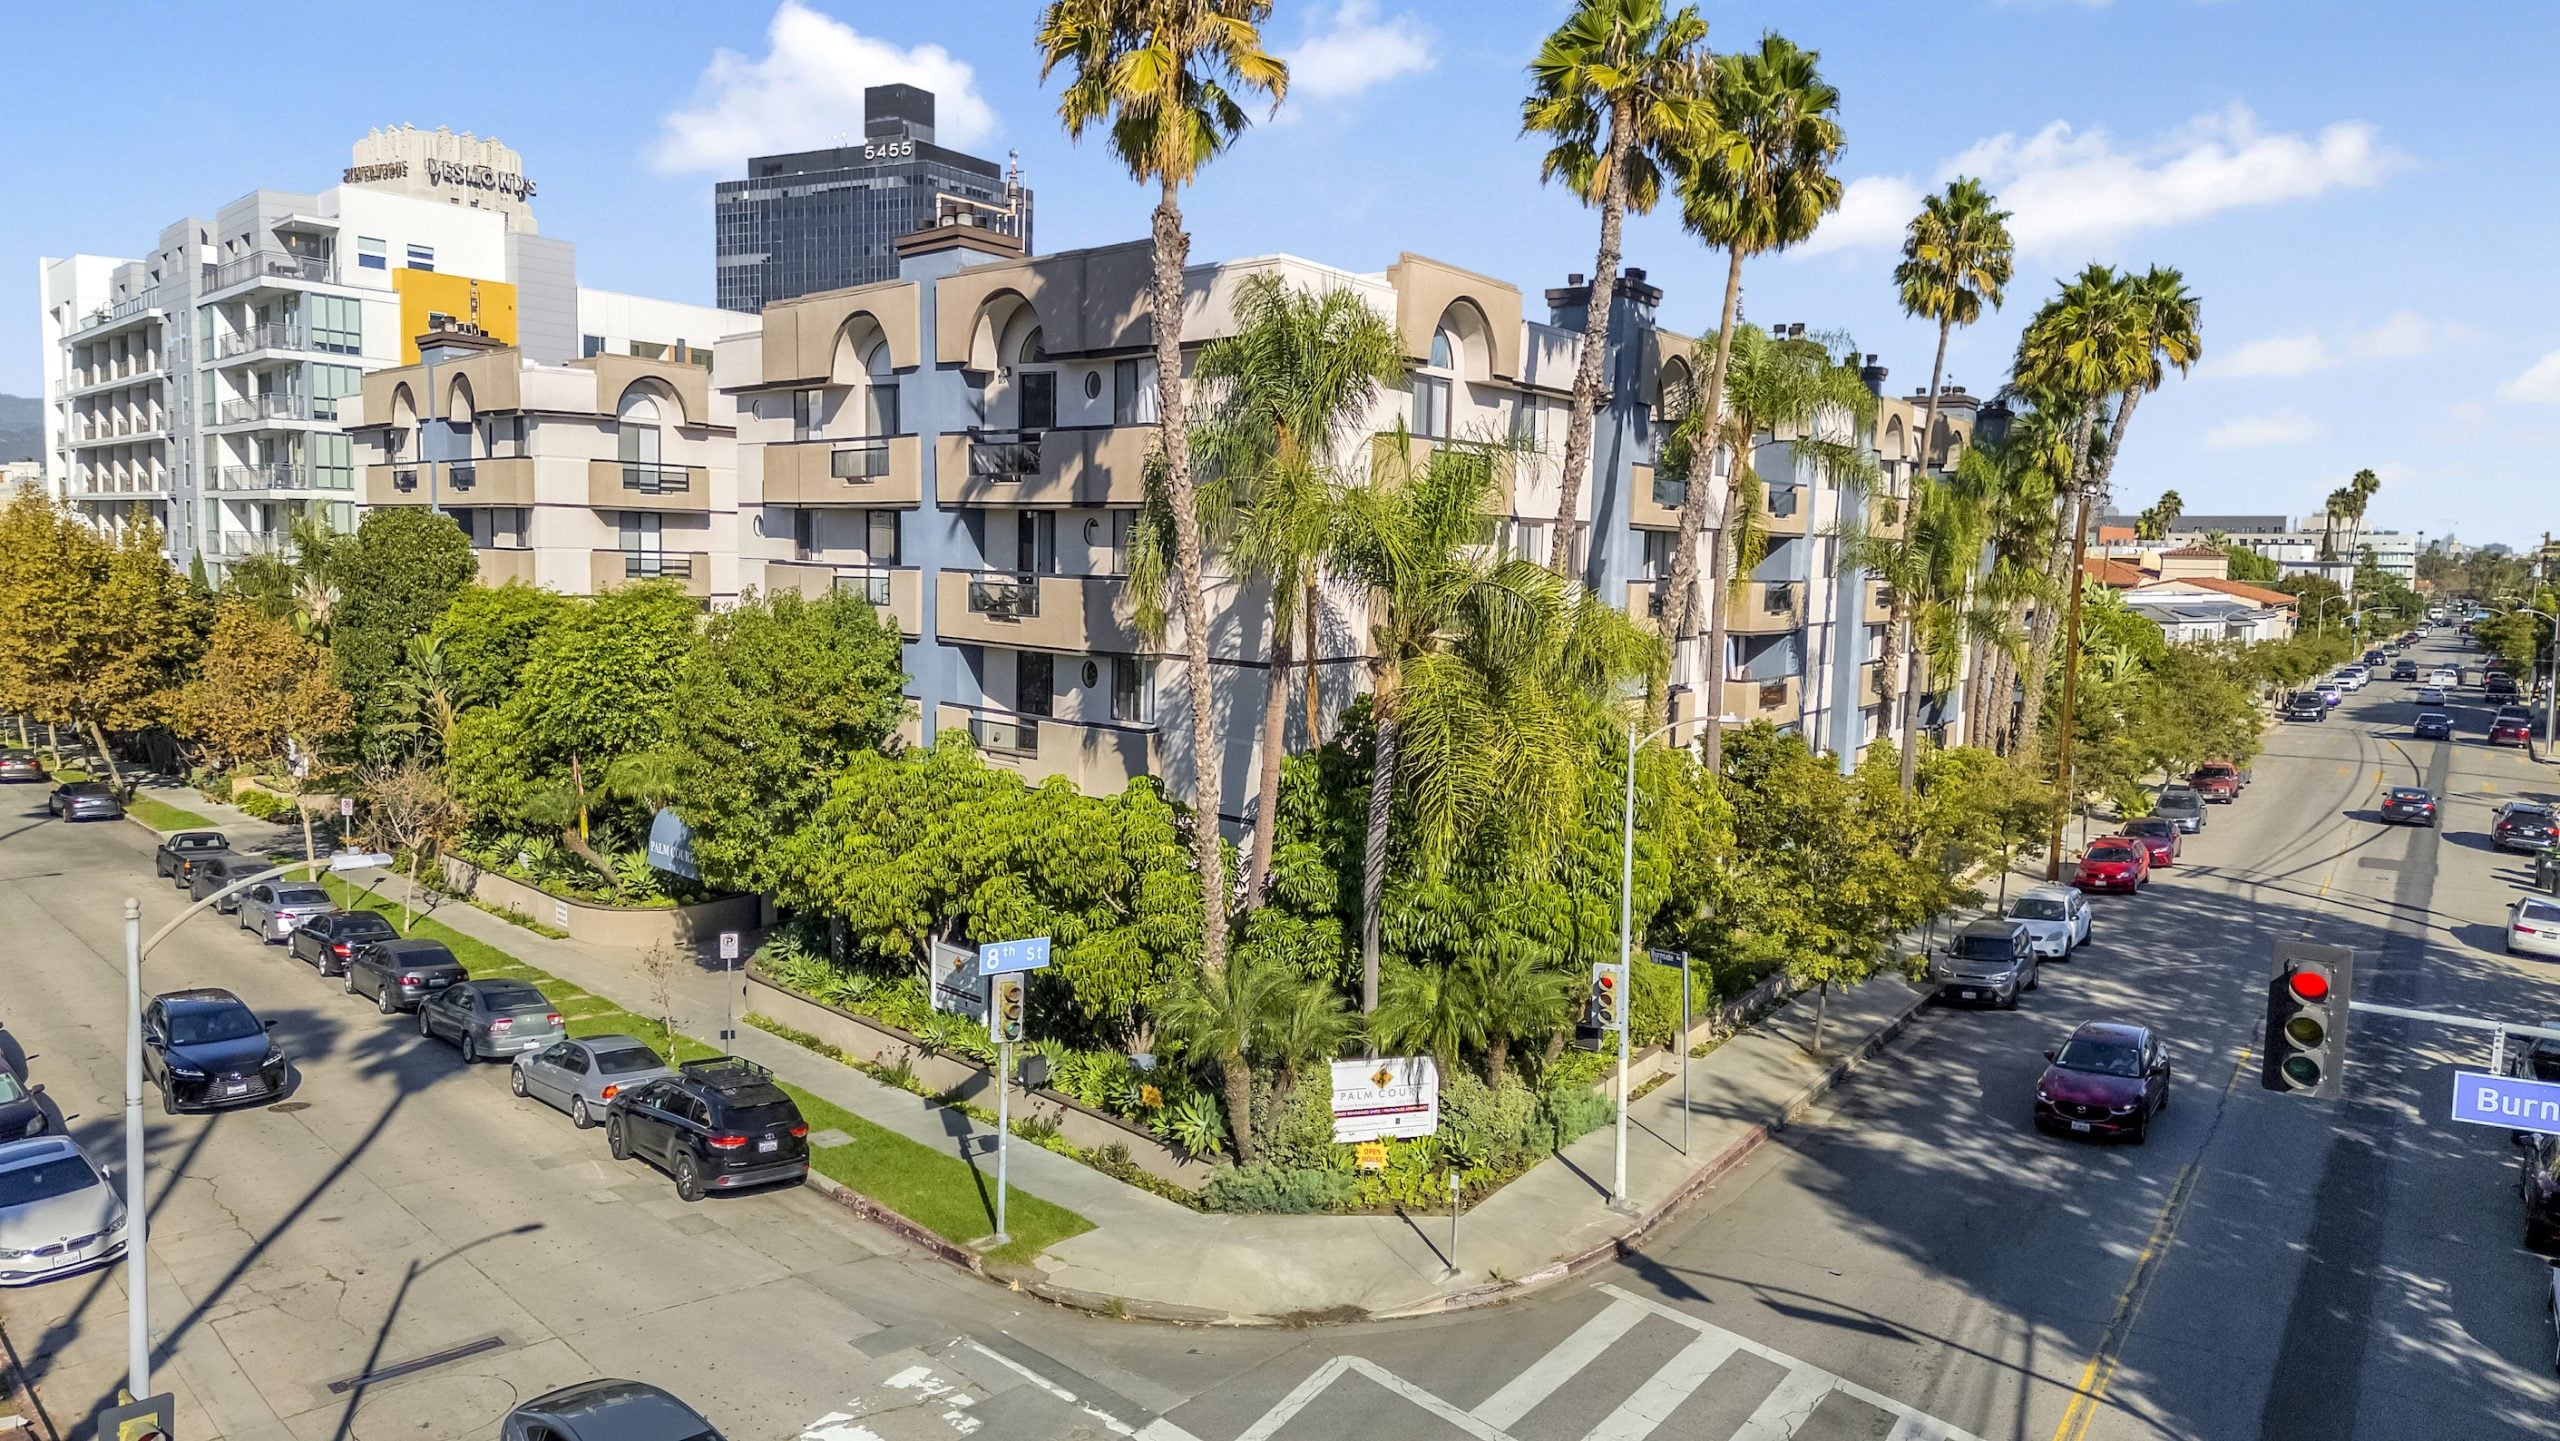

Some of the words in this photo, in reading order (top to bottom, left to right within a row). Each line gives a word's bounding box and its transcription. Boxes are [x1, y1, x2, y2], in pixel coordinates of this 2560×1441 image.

[864, 141, 912, 160] 5455
[651, 841, 670, 857] PALM
[986, 945, 1016, 970] 8th
[1026, 946, 1043, 962] St
[1340, 1091, 1373, 1101] PALM
[2477, 1087, 2560, 1121] Burn
[1361, 1156, 1384, 1164] HOUSE
[1363, 1148, 1382, 1156] OPEN
